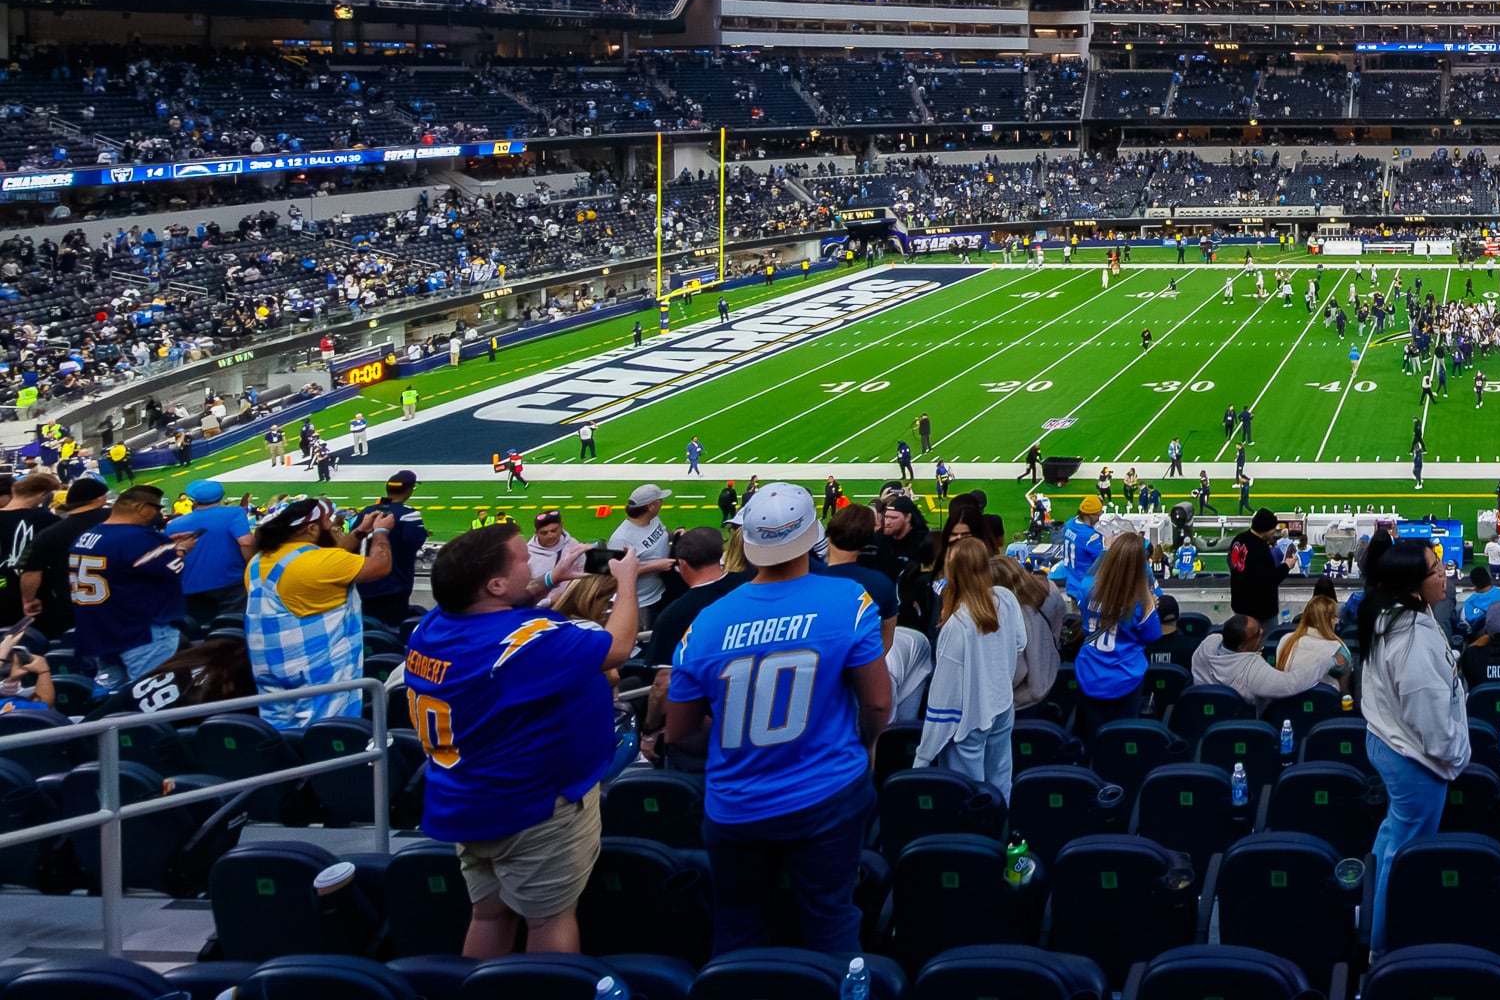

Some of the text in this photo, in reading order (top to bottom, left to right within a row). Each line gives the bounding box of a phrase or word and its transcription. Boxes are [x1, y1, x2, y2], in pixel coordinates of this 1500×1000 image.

[496, 144, 509, 152] 10
[217, 162, 235, 172] 31
[286, 157, 303, 167] 12
[309, 155, 334, 165] BALL
[334, 154, 349, 164] ON
[854, 209, 874, 219] WIN
[473, 279, 941, 425] CHARGERS
[217, 350, 254, 369] WE WIN
[822, 380, 891, 394] 10
[985, 380, 1054, 394] 20
[1153, 380, 1215, 393] 30
[1318, 381, 1379, 393] 40
[642, 523, 665, 550] RAIDER
[722, 613, 818, 651] HERBERT
[718, 648, 820, 750] 10
